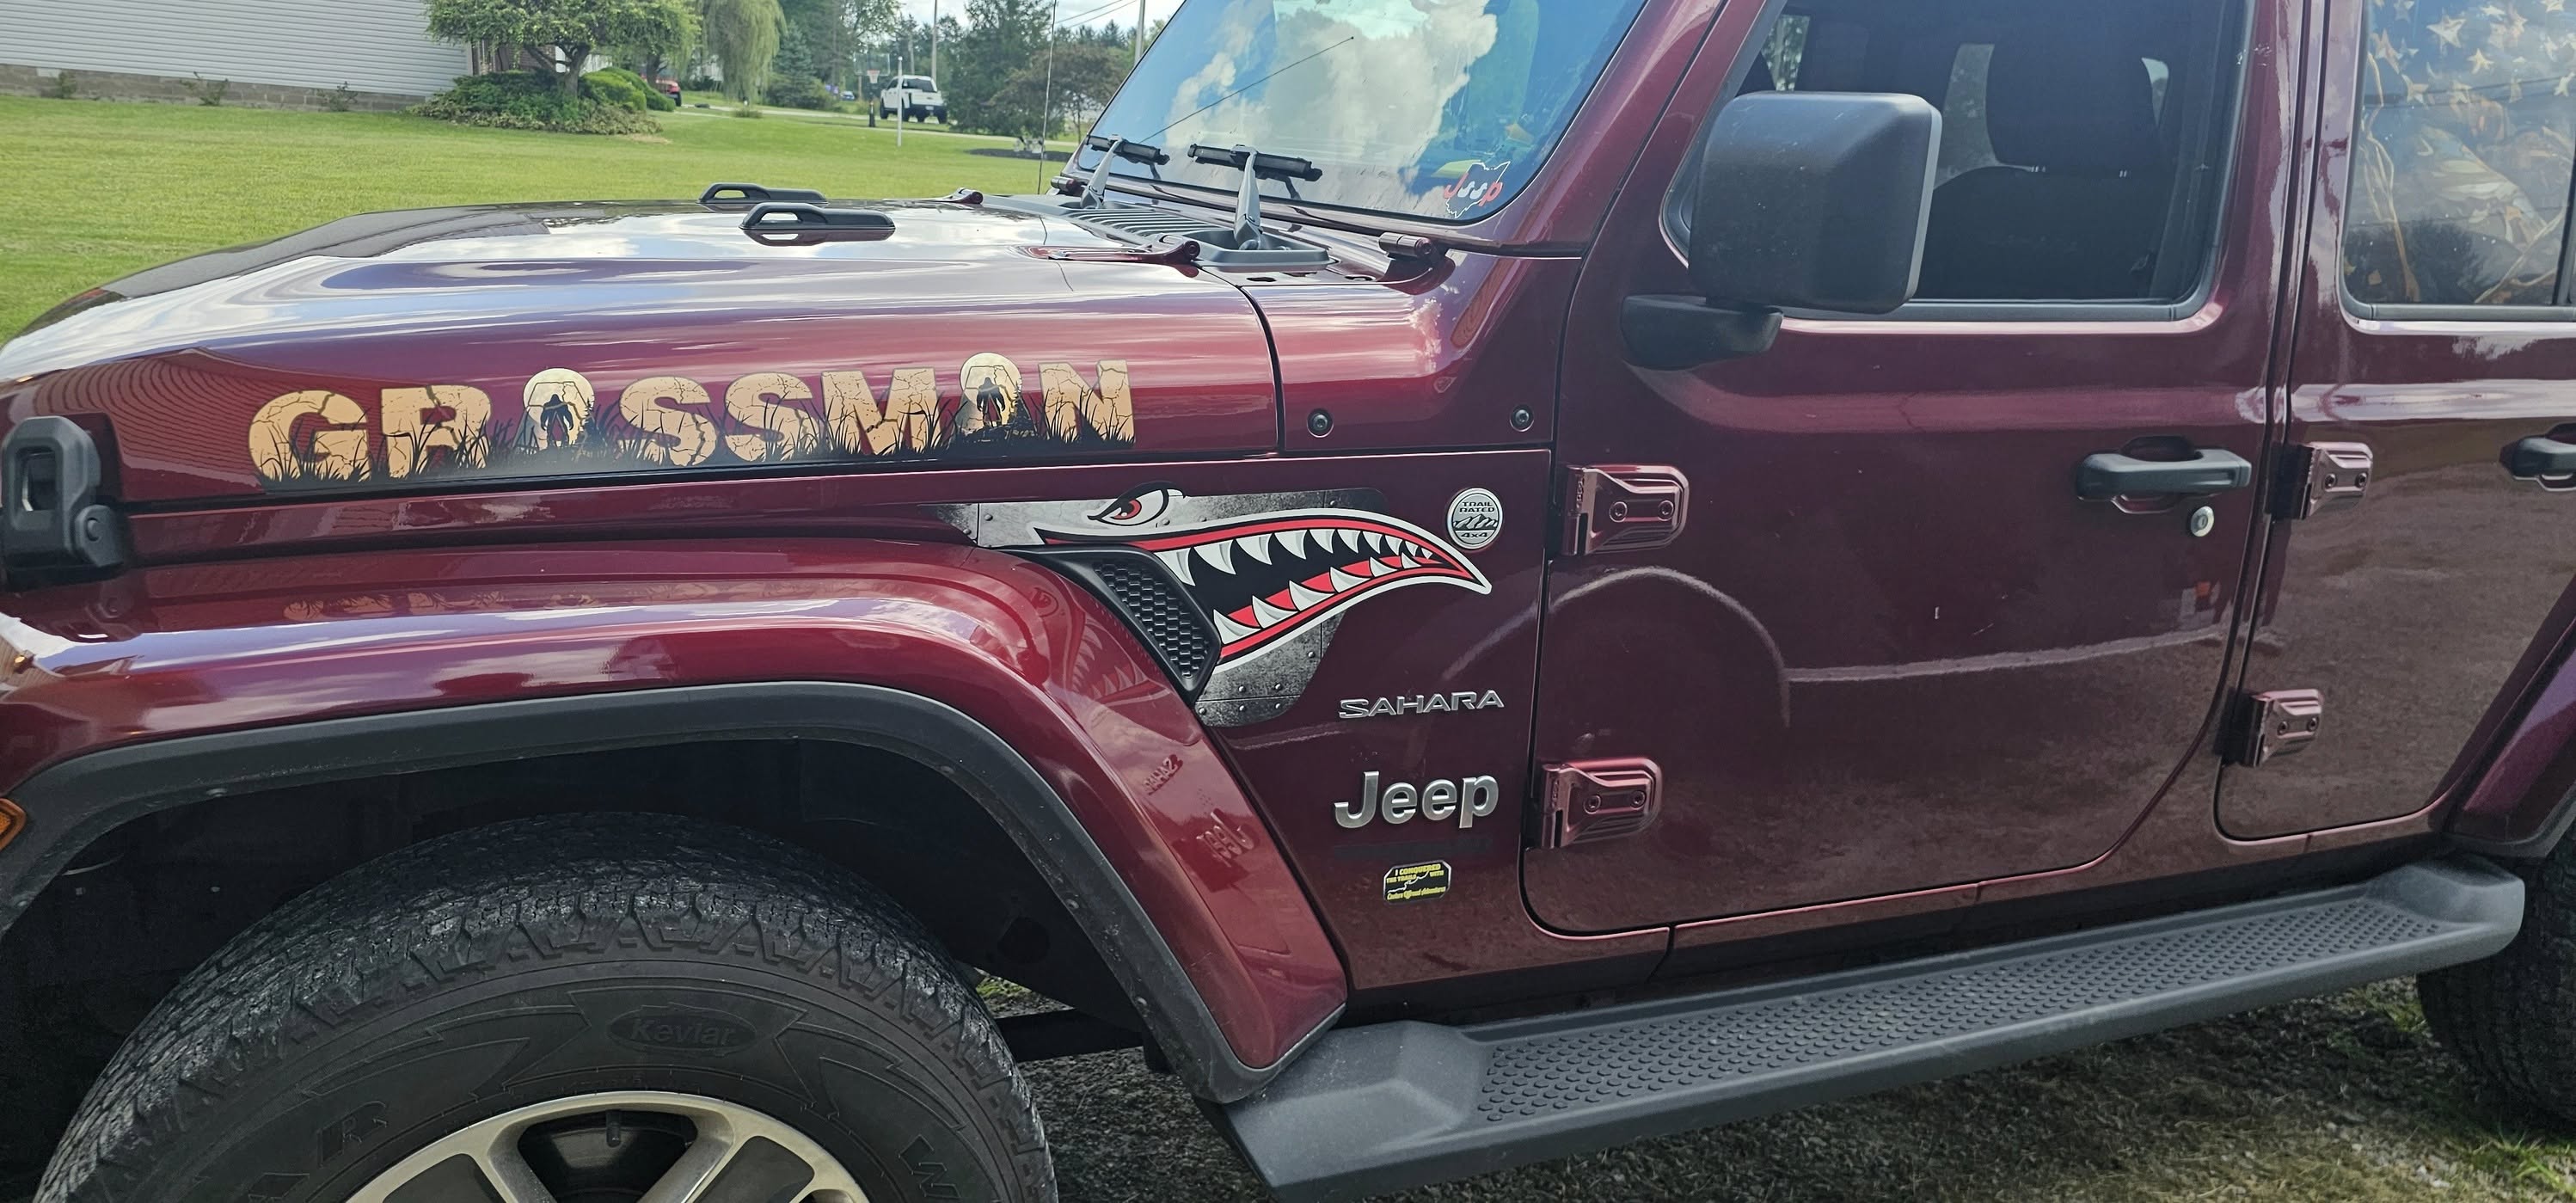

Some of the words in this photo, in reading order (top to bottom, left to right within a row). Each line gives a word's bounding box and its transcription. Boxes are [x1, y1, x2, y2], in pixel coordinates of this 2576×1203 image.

[1339, 690, 1505, 719] SAHARA
[1334, 770, 1500, 829] Jeep
[629, 1016, 737, 1046] Kevlar
